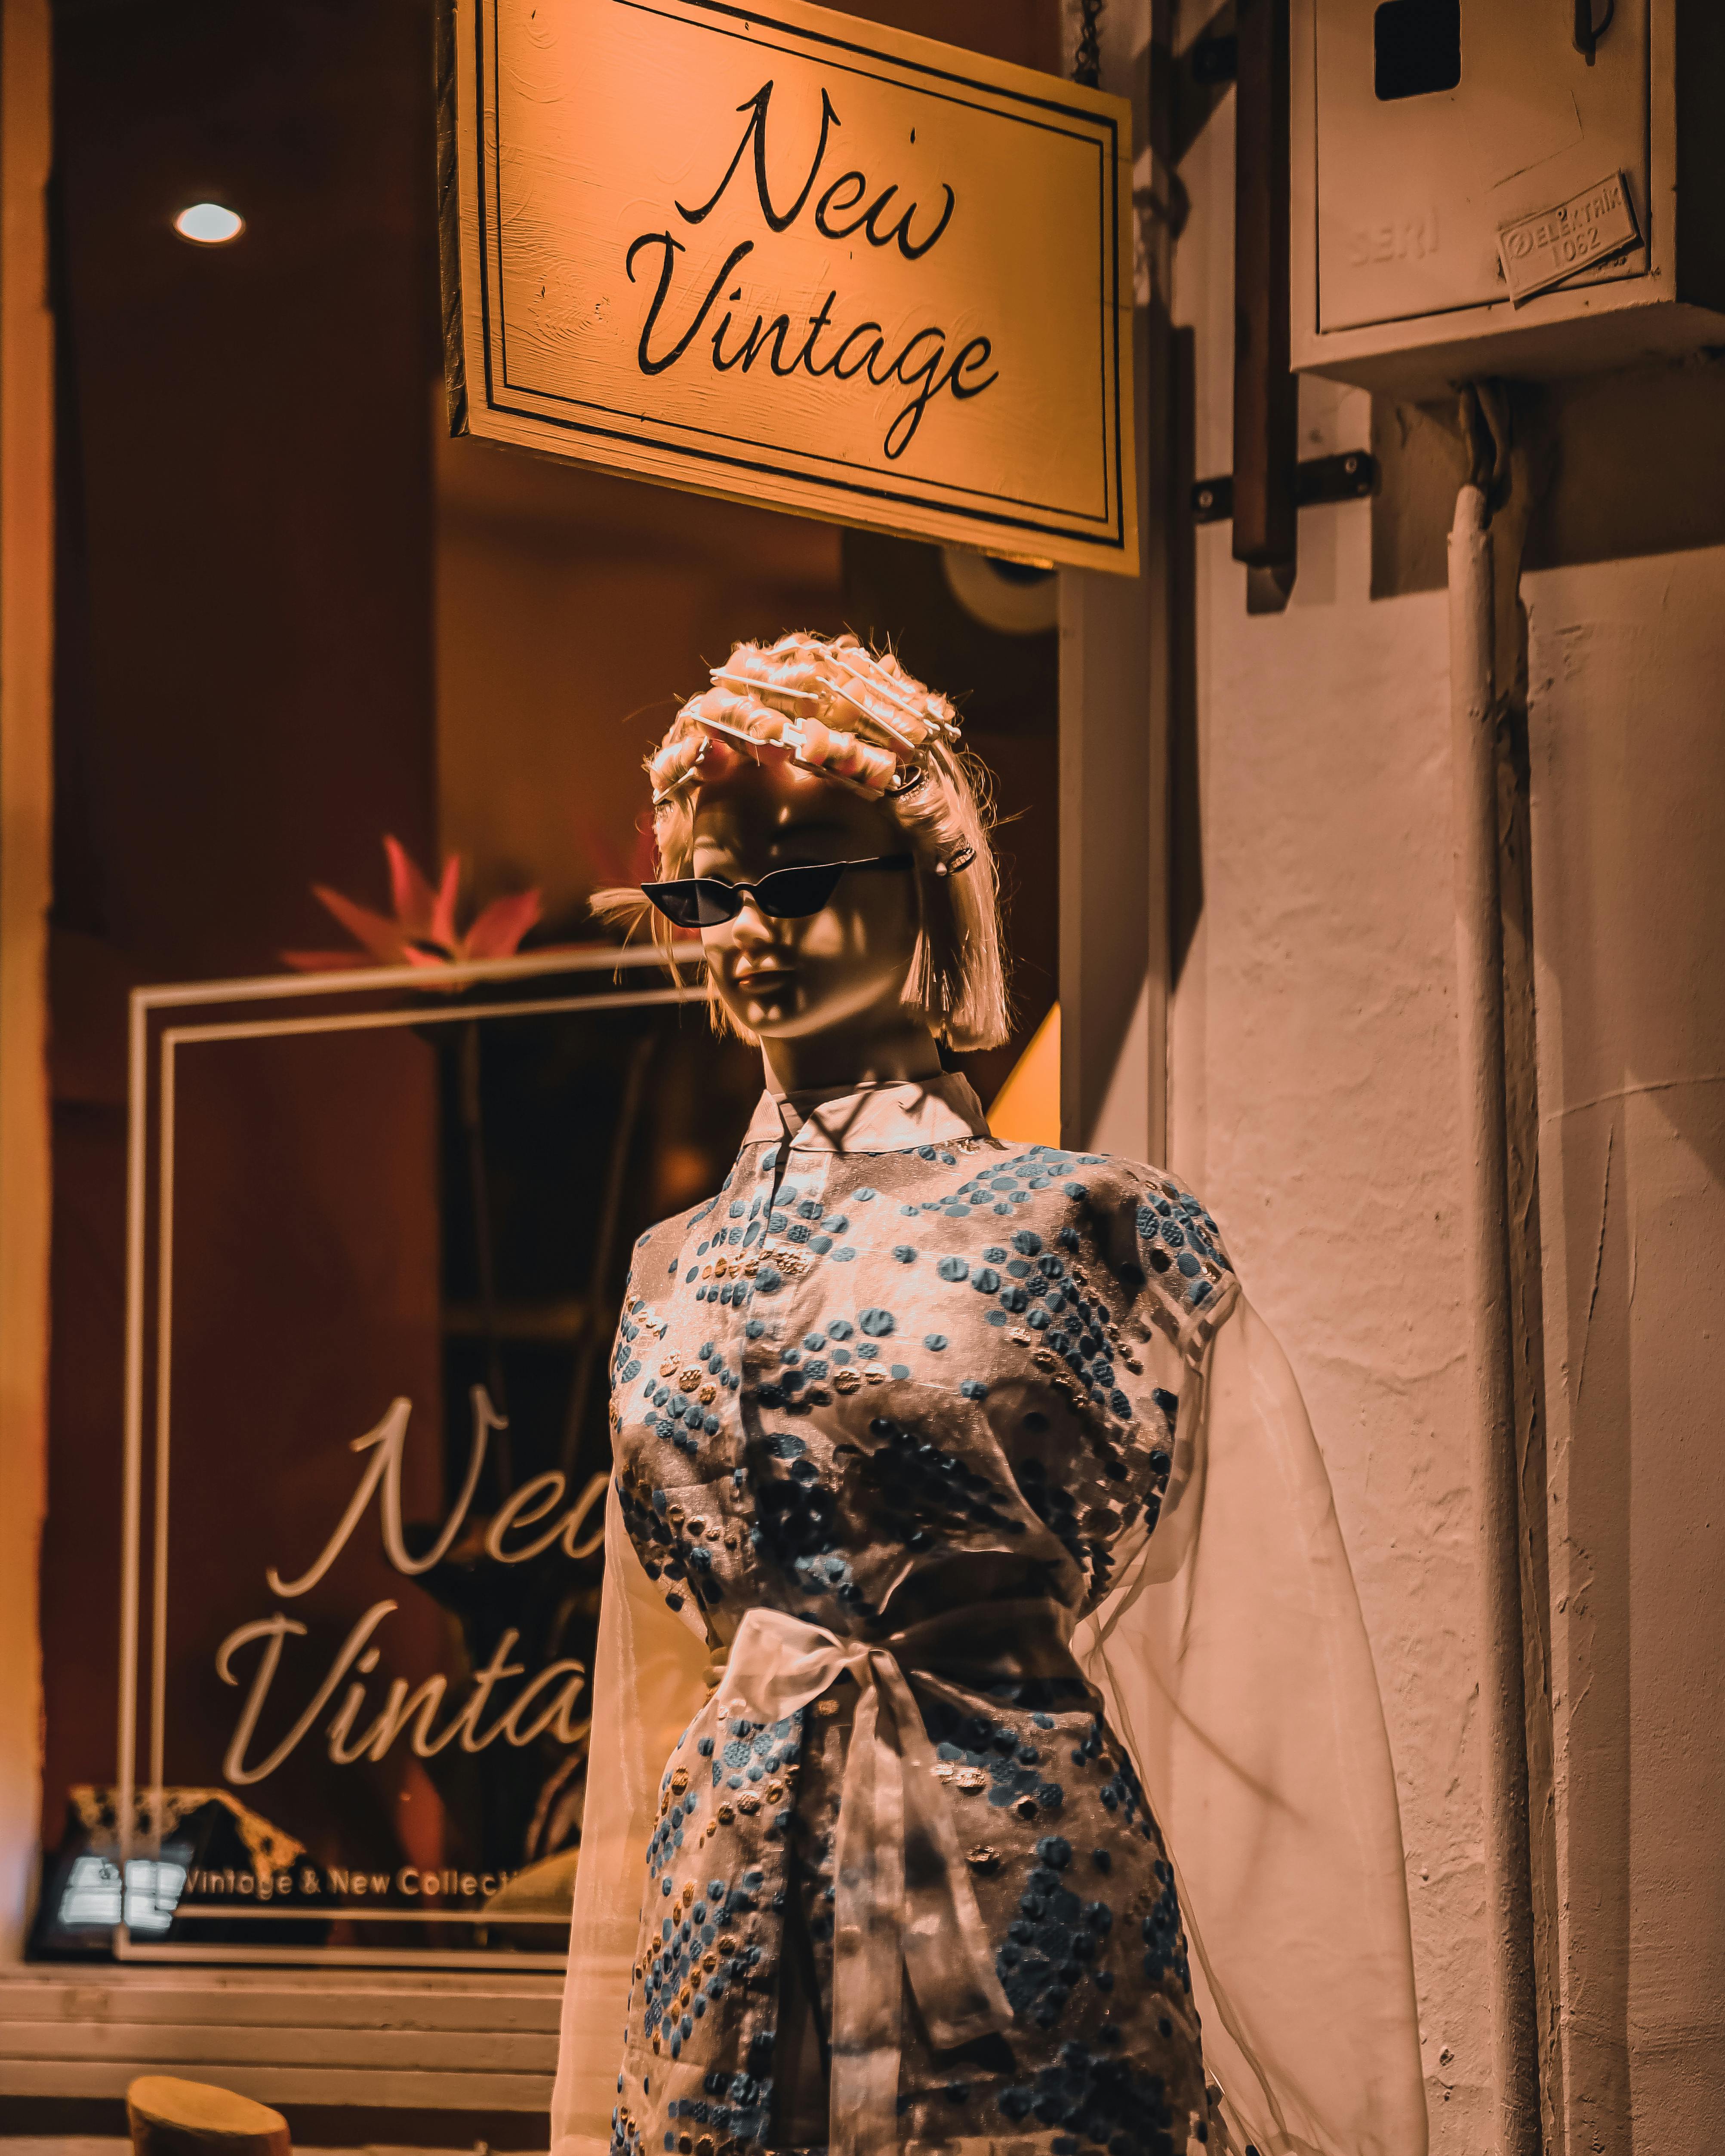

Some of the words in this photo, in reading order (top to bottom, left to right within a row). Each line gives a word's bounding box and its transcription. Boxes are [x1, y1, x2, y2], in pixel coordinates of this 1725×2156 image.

[675, 80, 955, 259] New
[1552, 227, 1601, 267] 1062
[626, 231, 998, 459] Vintage
[215, 1599, 592, 1785] Vinta
[300, 1865, 322, 1896] &
[326, 1865, 391, 1895] New
